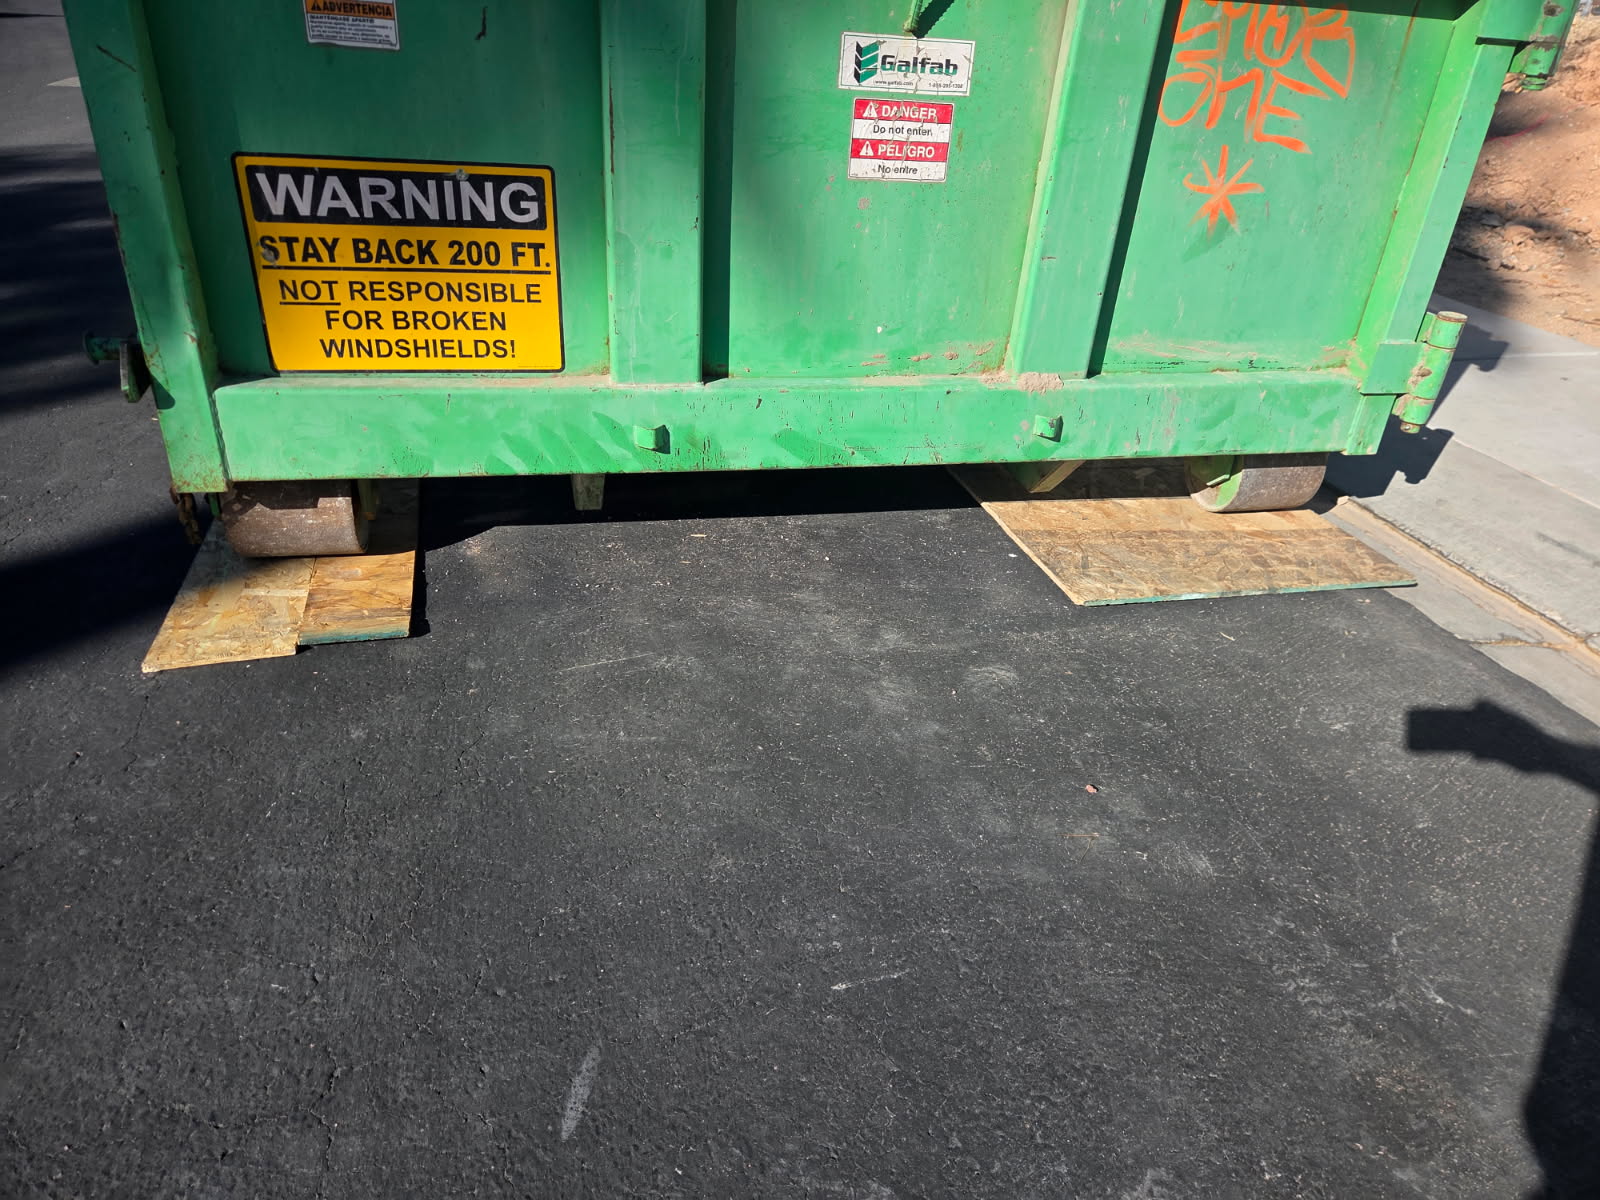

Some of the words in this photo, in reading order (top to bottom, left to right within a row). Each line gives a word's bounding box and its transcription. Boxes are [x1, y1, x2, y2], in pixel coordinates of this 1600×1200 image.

[322, 2, 392, 17] ADVERTENCIA
[880, 54, 958, 76] Galfab
[881, 105, 937, 120] DANGER
[873, 125, 886, 134] Do
[888, 126, 904, 135] not
[906, 127, 932, 137] enter
[878, 144, 935, 158] PELIGRO
[878, 165, 891, 174] No
[893, 165, 918, 175] entre
[256, 172, 540, 223] WARNING
[260, 235, 340, 264] STAY
[352, 238, 439, 265] BACK
[448, 240, 501, 266] 200
[511, 242, 551, 268] FT.
[279, 279, 339, 301] NOT
[349, 281, 542, 303] RESPONSIBLE
[325, 310, 384, 330] FOR
[392, 310, 506, 331] BROKEN
[320, 338, 516, 358] WINDSHIELDS!
